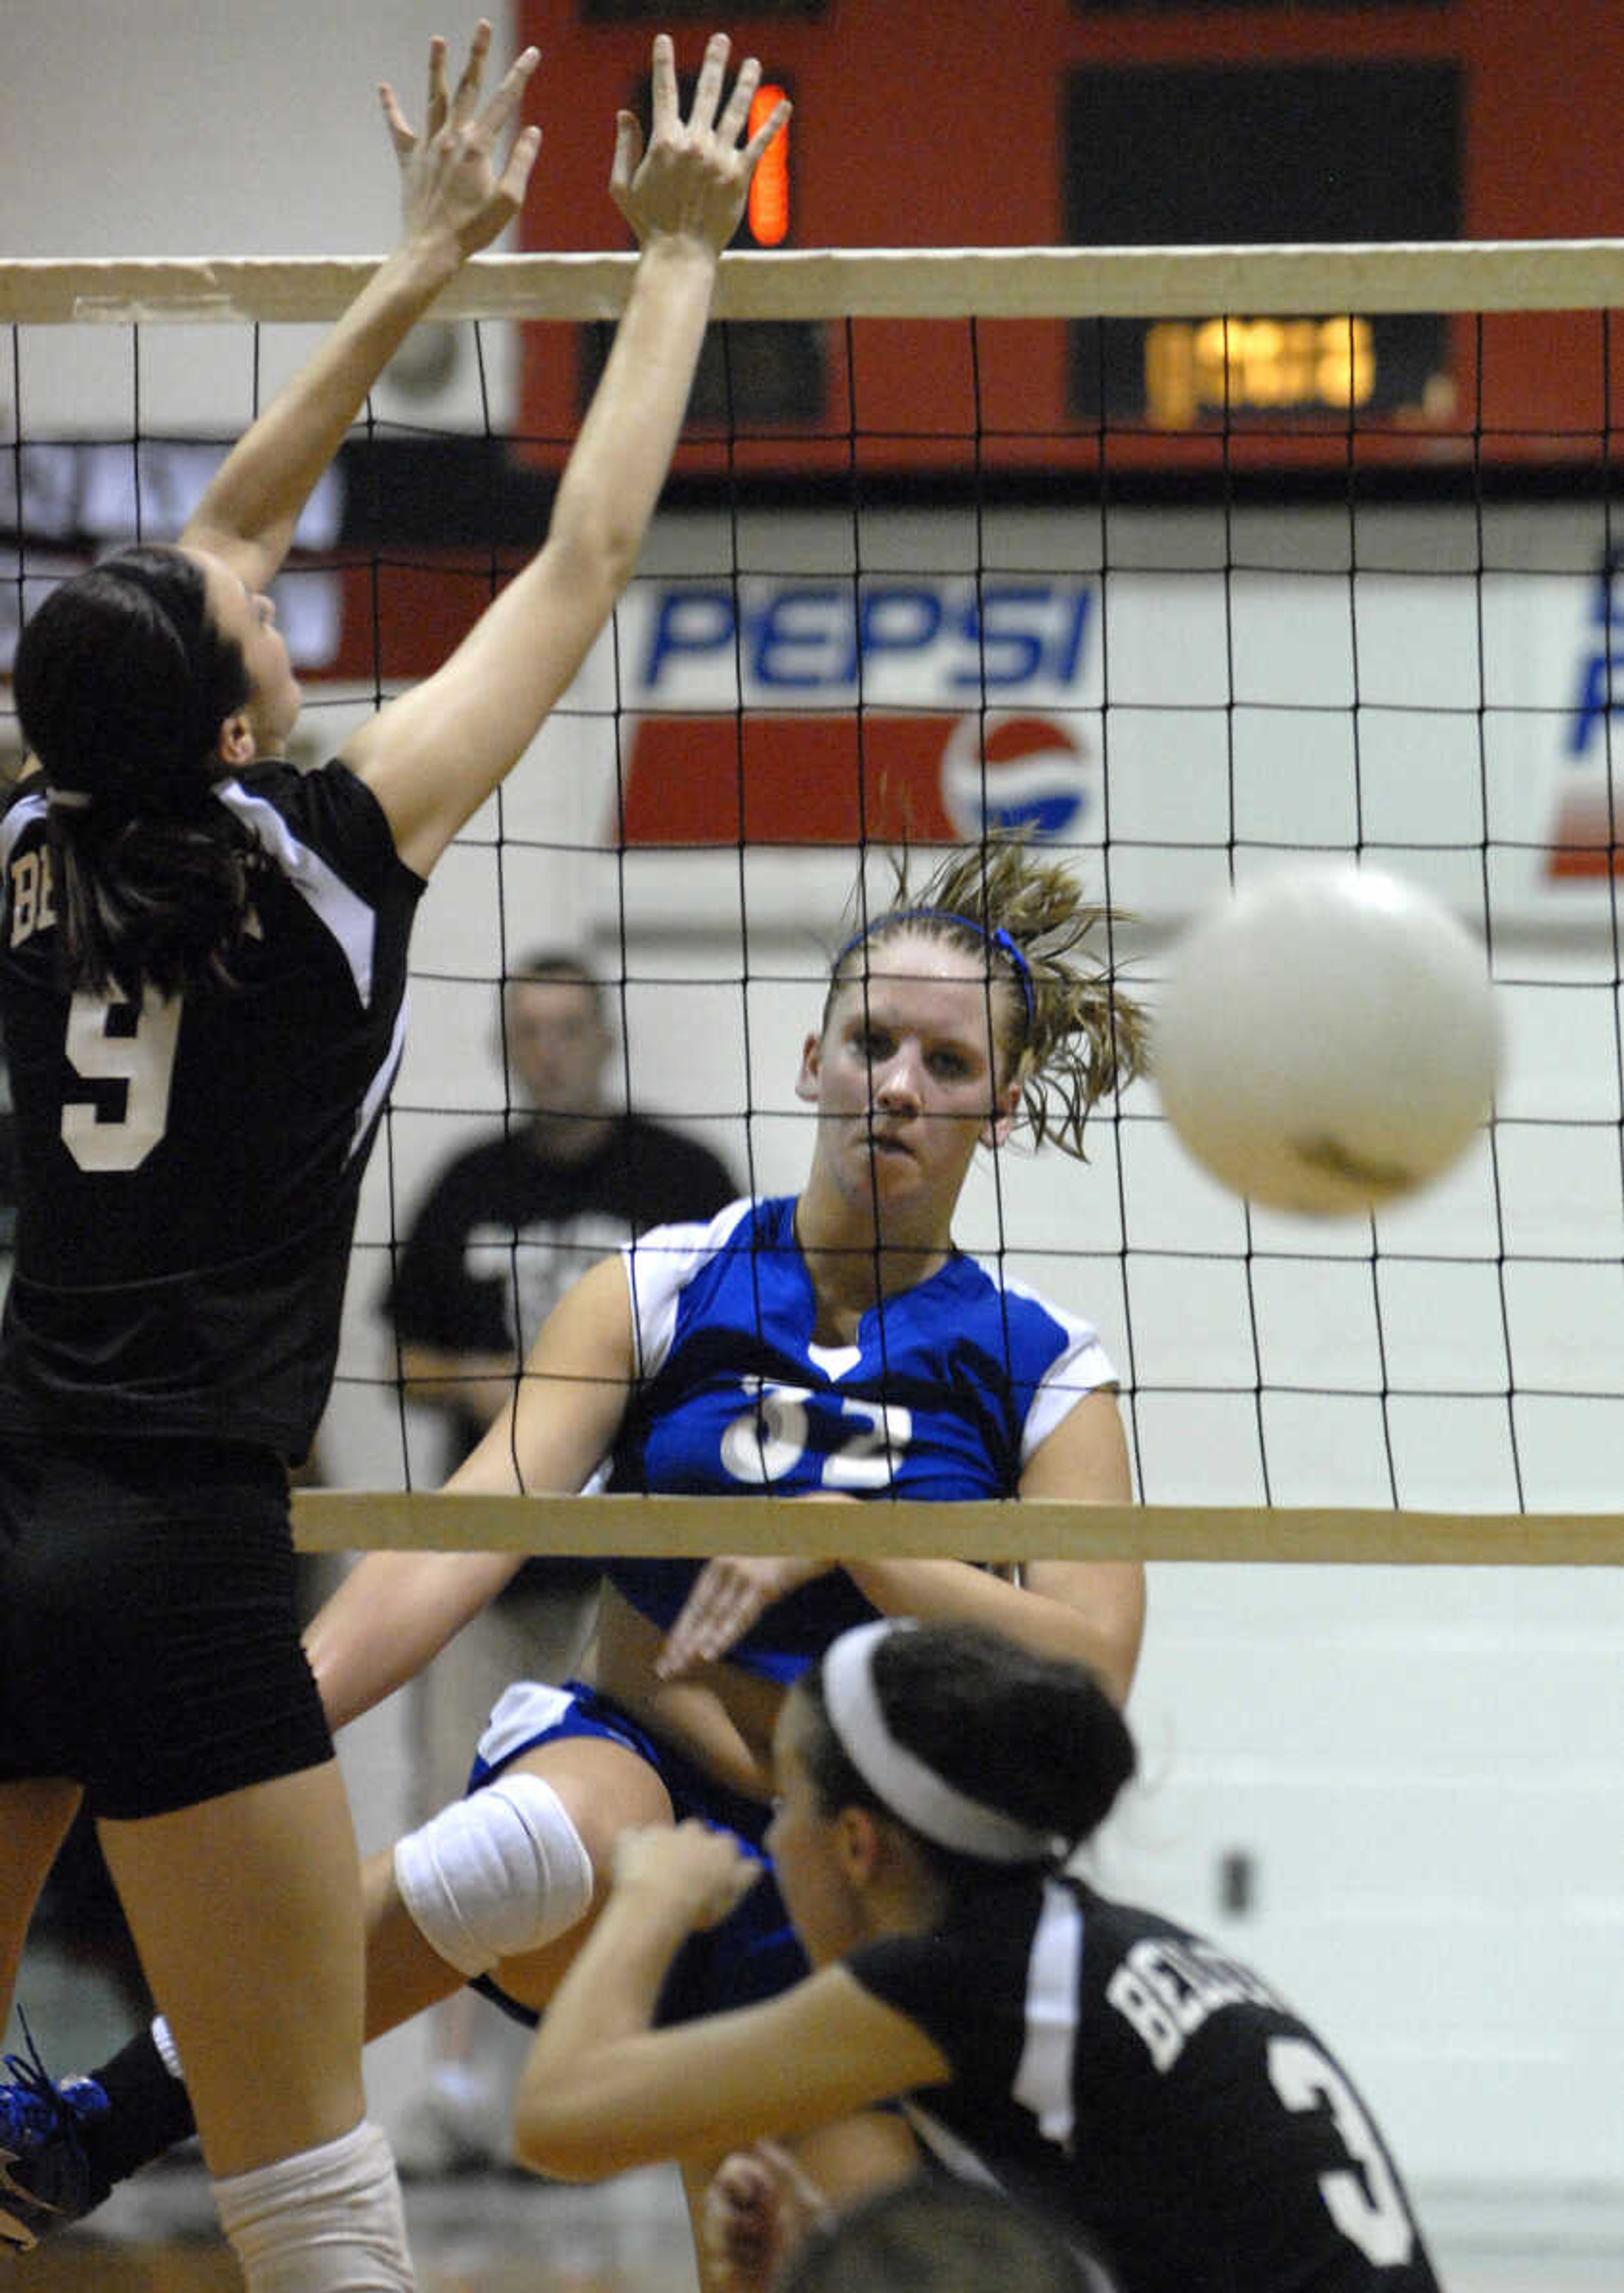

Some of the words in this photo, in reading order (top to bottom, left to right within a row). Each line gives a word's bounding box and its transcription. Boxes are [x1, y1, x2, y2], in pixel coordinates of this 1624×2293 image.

[643, 586, 1095, 689] PEPSI
[61, 978, 183, 1171] 9
[1267, 2035, 1413, 2267] 3
